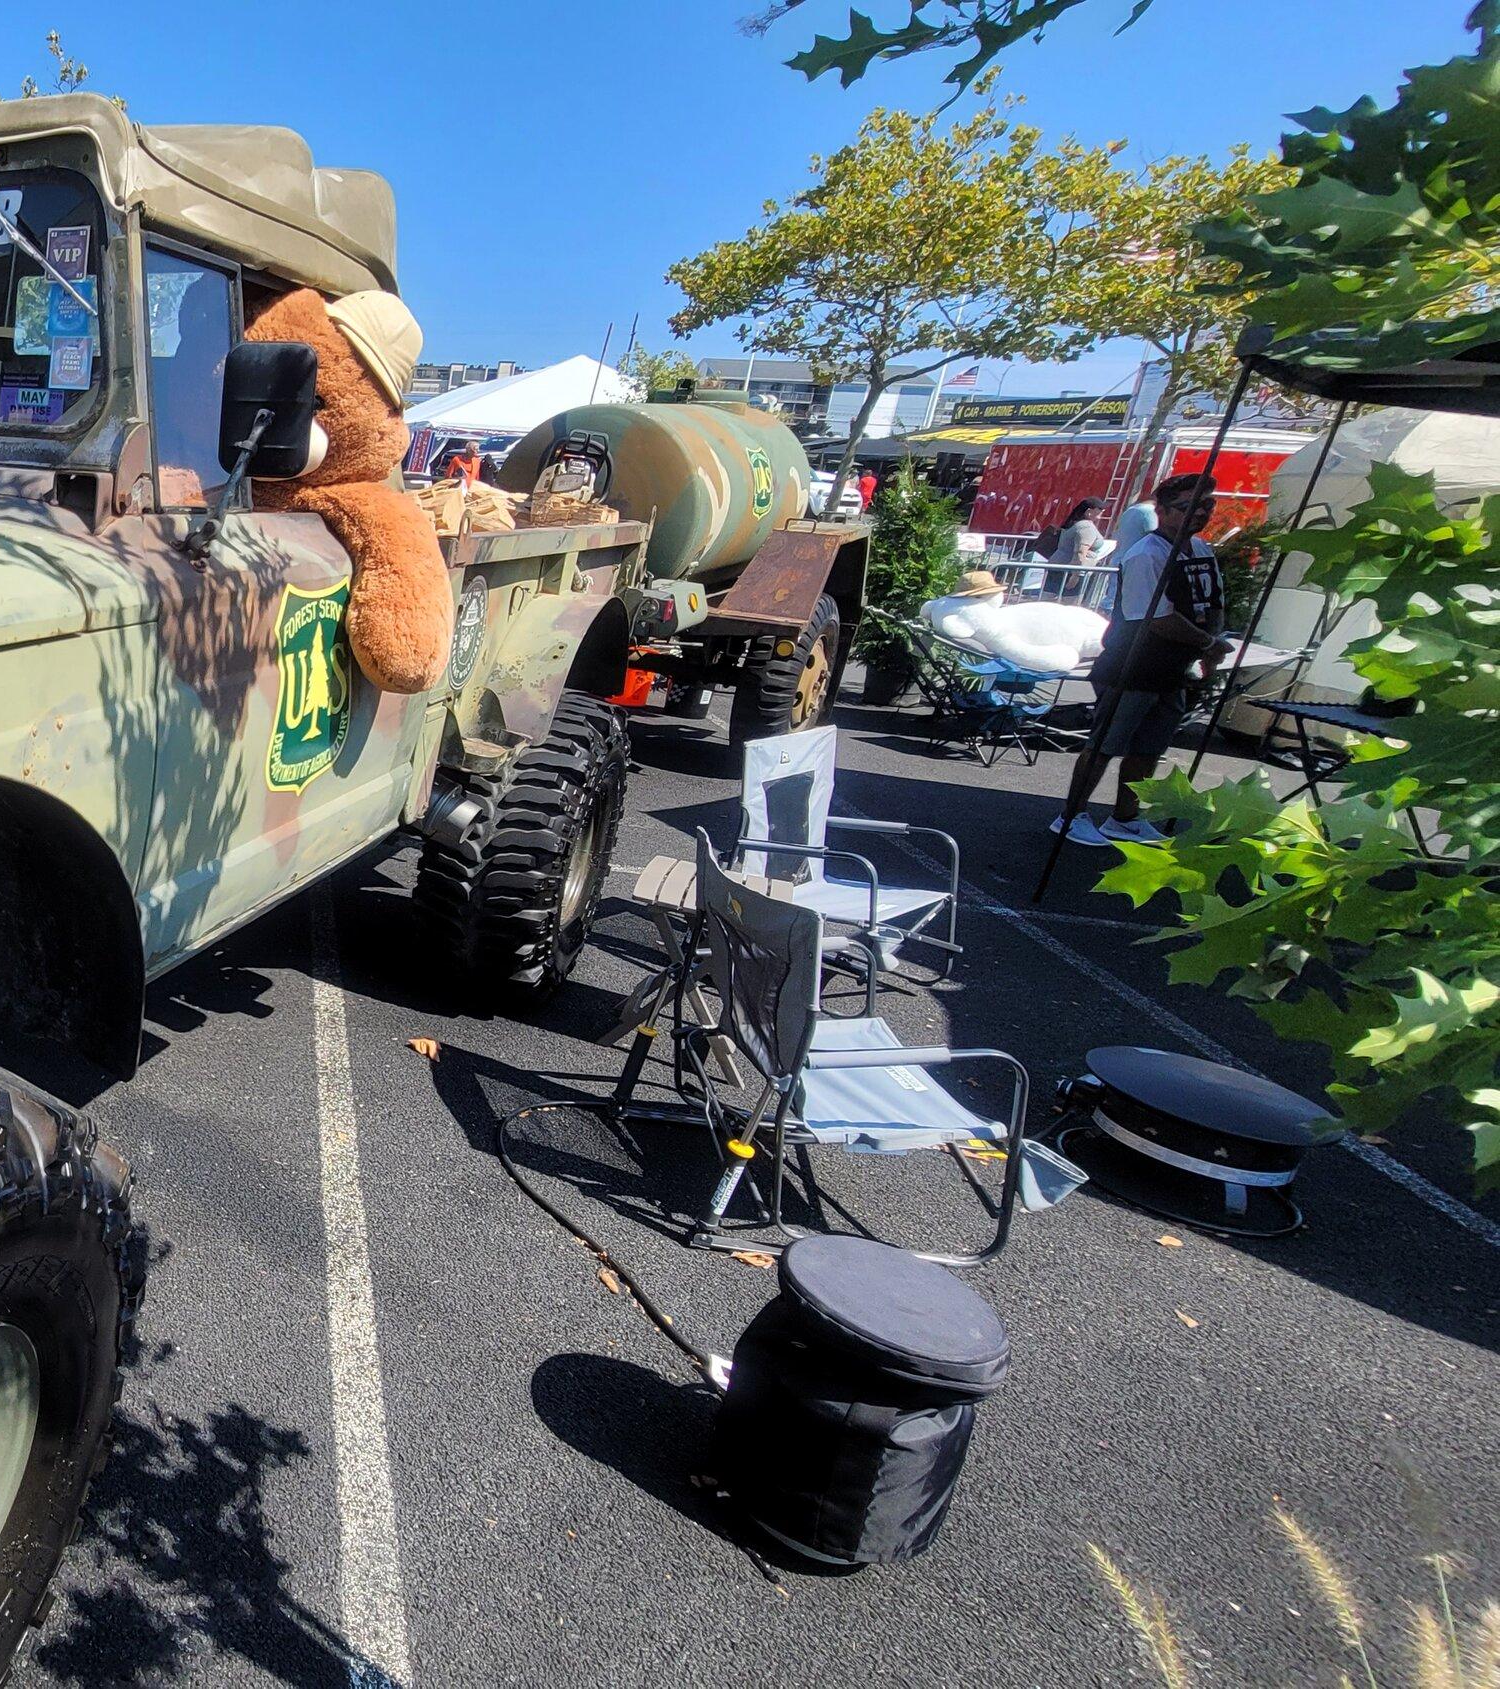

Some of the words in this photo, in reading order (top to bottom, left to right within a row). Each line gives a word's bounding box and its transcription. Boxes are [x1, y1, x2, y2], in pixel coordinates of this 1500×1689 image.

[53, 247, 82, 263] VIP
[20, 390, 47, 404] MAY
[963, 406, 980, 418] CAR
[983, 405, 1015, 417] MARINE
[1018, 402, 1083, 416] POWERSPORTS
[283, 600, 319, 648] FOREST
[318, 598, 343, 622] SERV
[710, 1167, 733, 1208] FIREPIT
